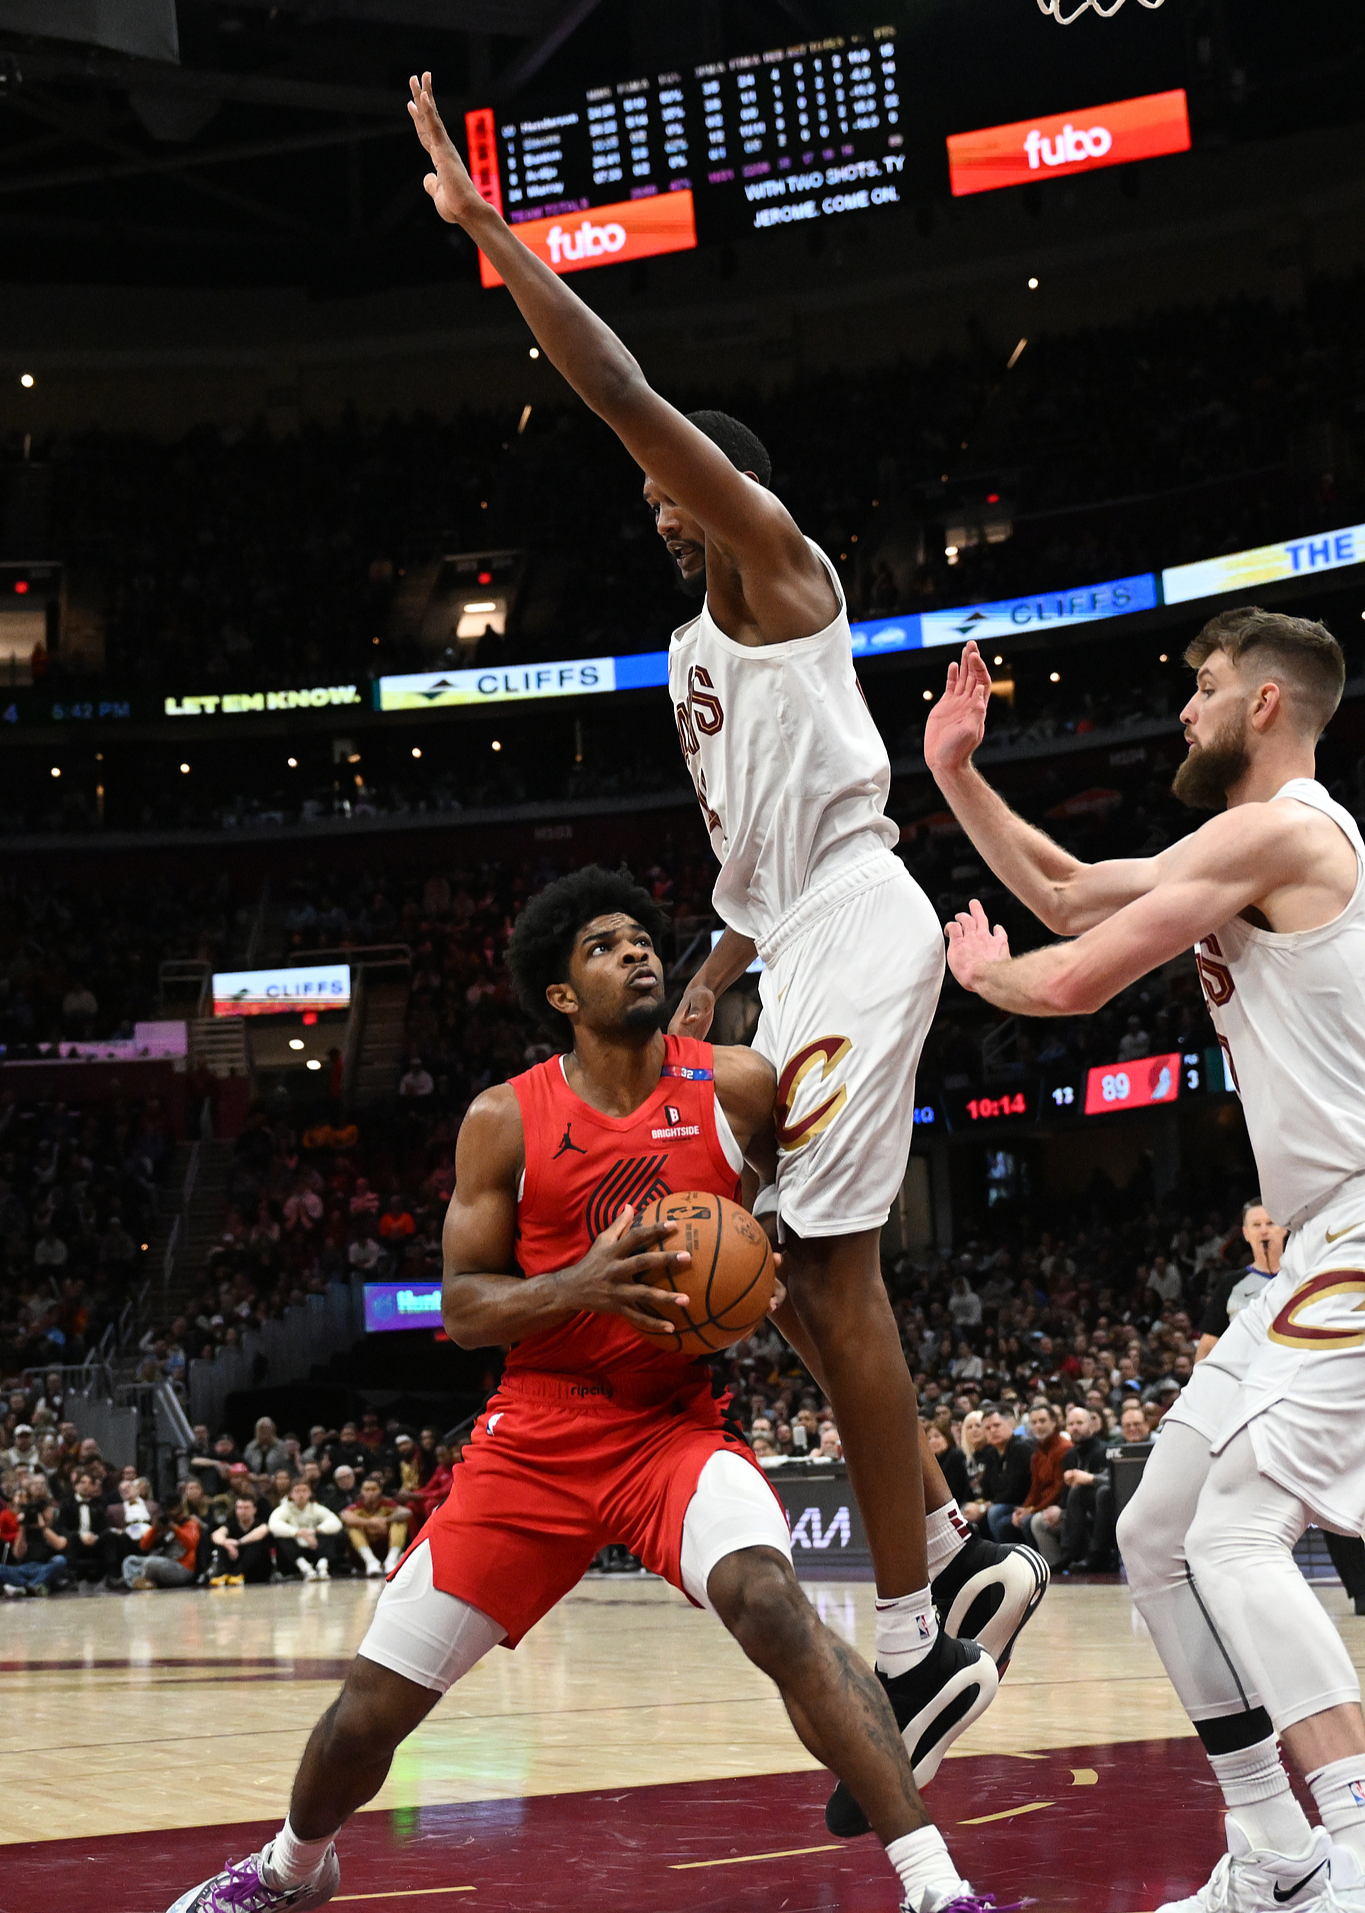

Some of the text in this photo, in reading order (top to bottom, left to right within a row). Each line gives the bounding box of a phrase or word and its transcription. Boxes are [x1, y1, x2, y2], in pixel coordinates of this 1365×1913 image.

[1023, 124, 1112, 169] fubo
[745, 178, 786, 201] WITH
[786, 171, 824, 193] TWO
[882, 154, 906, 173] TY
[822, 189, 870, 214] COME
[546, 221, 626, 263] fubo
[1285, 533, 1354, 571] THE
[1010, 585, 1132, 625] CLIFFS
[477, 666, 600, 695] CLIFFS
[164, 694, 220, 716] LET
[222, 692, 265, 713] EM
[266, 980, 343, 999] CLIFFS
[681, 1066, 694, 1080] 32
[1101, 1072, 1131, 1102] 89
[1187, 1069, 1199, 1095] 3
[965, 1092, 1027, 1121] 10:14
[651, 1125, 700, 1139] BRIGHTSIDE
[571, 1382, 614, 1400] ripcity
